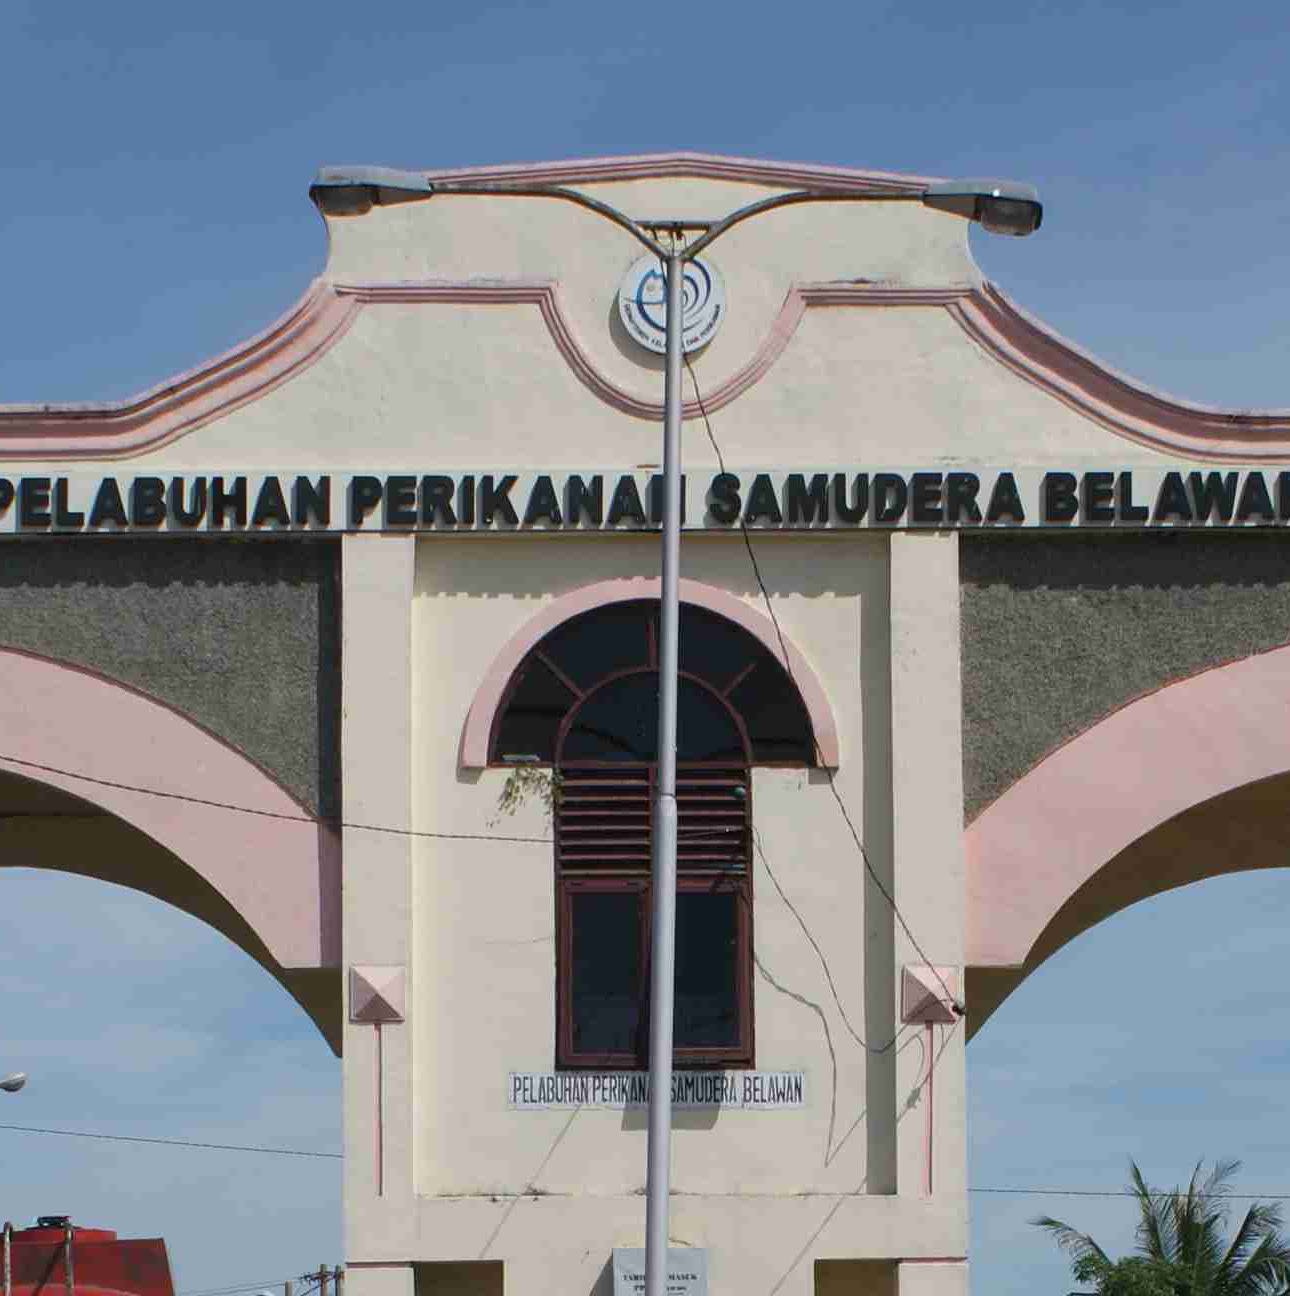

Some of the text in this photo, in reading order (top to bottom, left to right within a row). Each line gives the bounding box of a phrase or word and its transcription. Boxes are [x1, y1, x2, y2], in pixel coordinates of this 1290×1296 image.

[710, 471, 1025, 524] SAMUDERA
[512, 1075, 589, 1104] PELABUHAN
[592, 1075, 652, 1104] PERIKAN
[742, 1075, 803, 1104] BELAWAN
